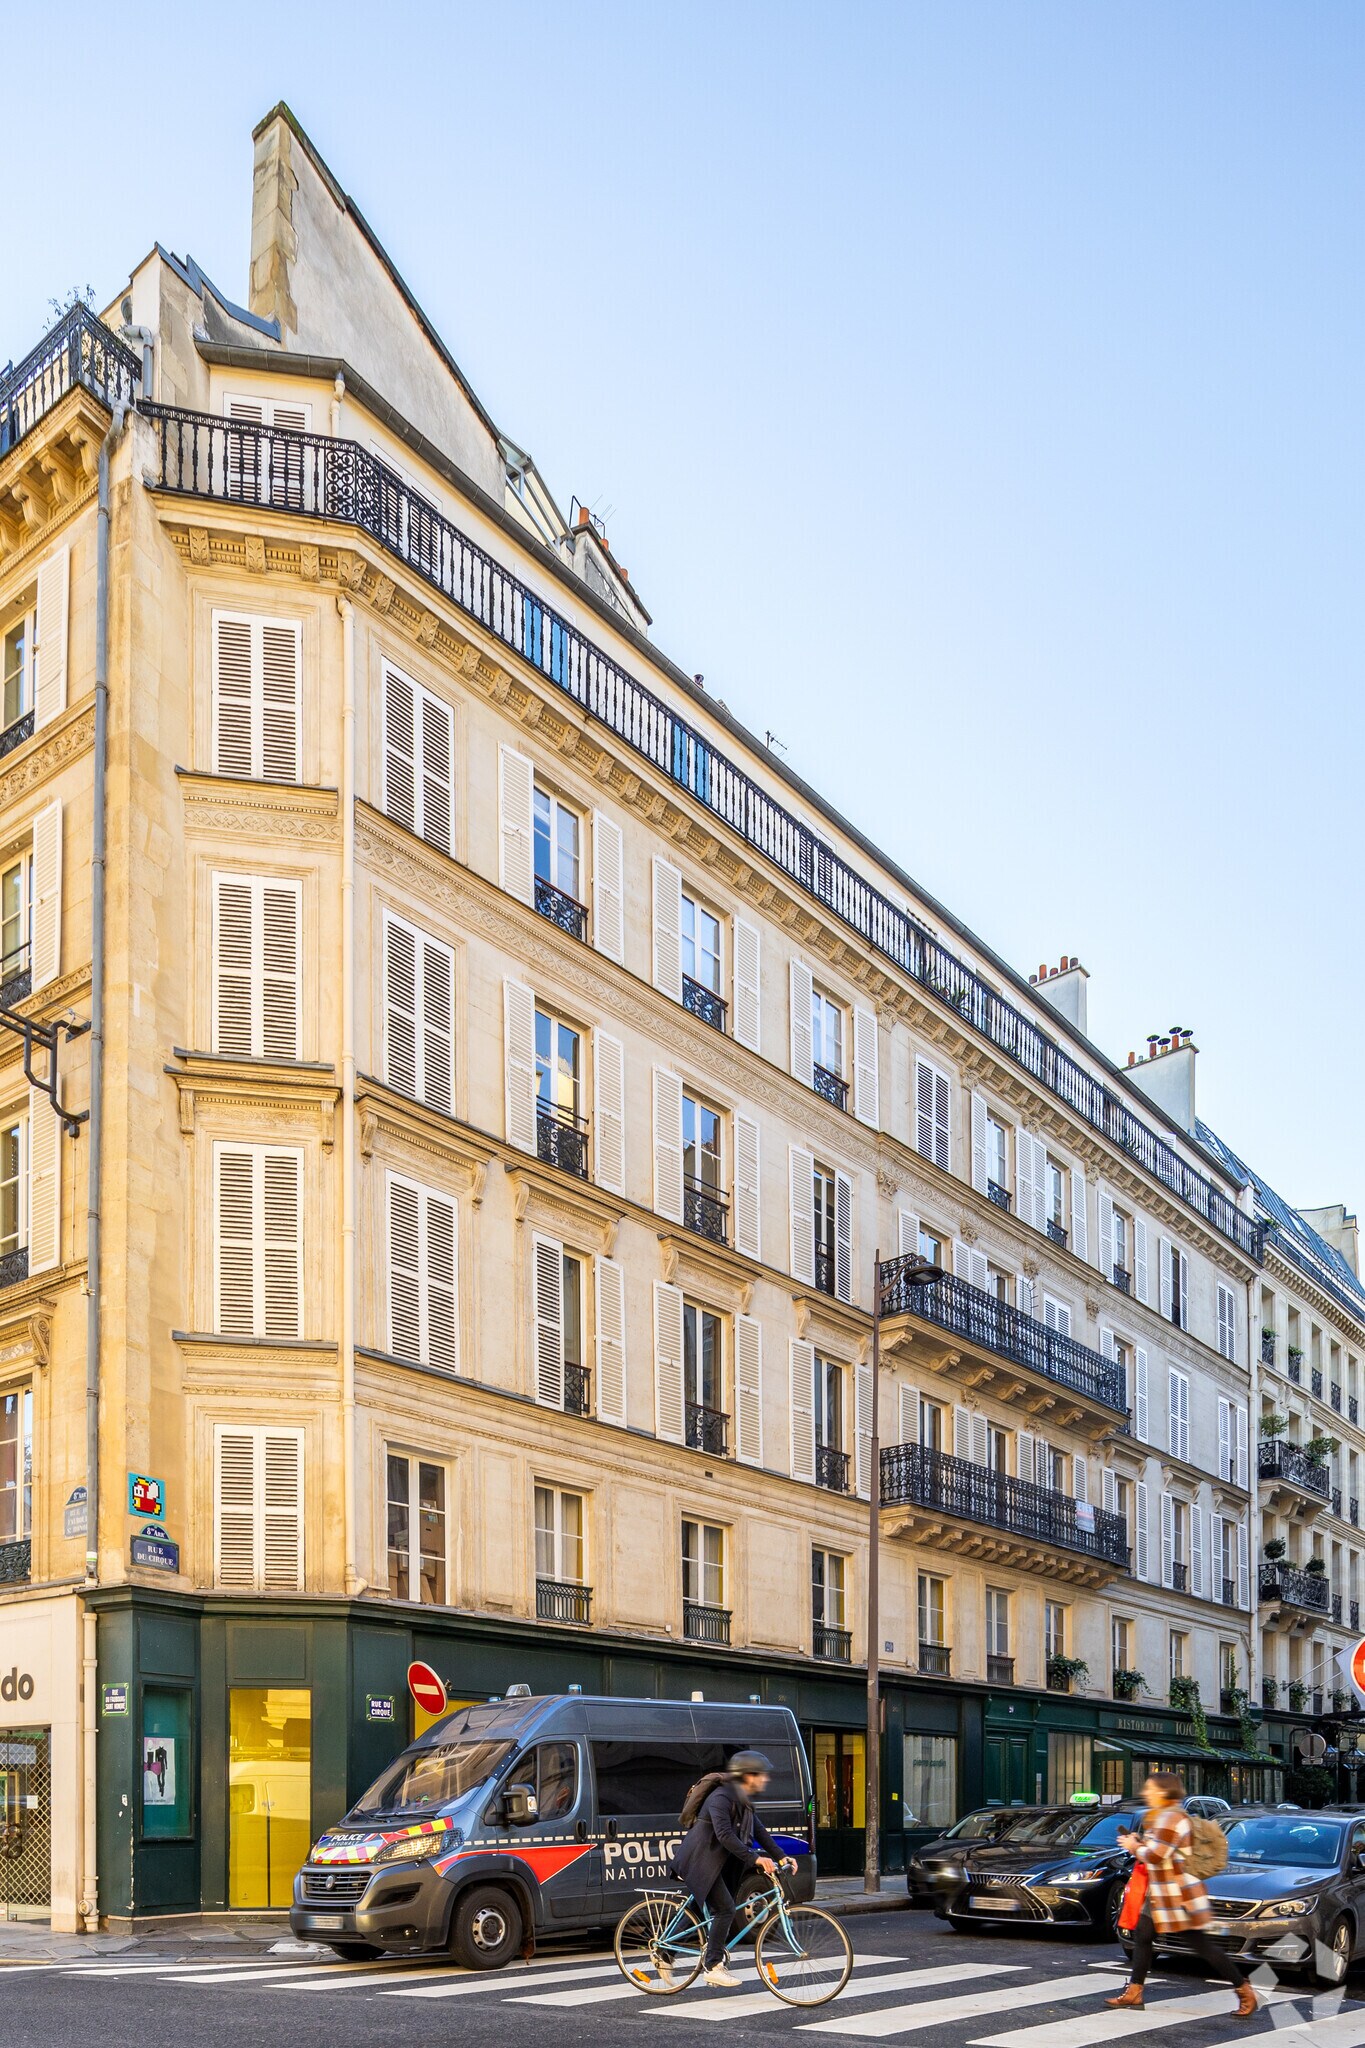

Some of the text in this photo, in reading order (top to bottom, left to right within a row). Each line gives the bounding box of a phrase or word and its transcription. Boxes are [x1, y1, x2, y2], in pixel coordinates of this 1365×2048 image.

[147, 1545, 164, 1555] RUE
[137, 1552, 174, 1566] DU CIRQUE
[1118, 1719, 1163, 1733] RISTORANTE
[1175, 1721, 1197, 1737] TOSC
[331, 1833, 366, 1841] POLICE
